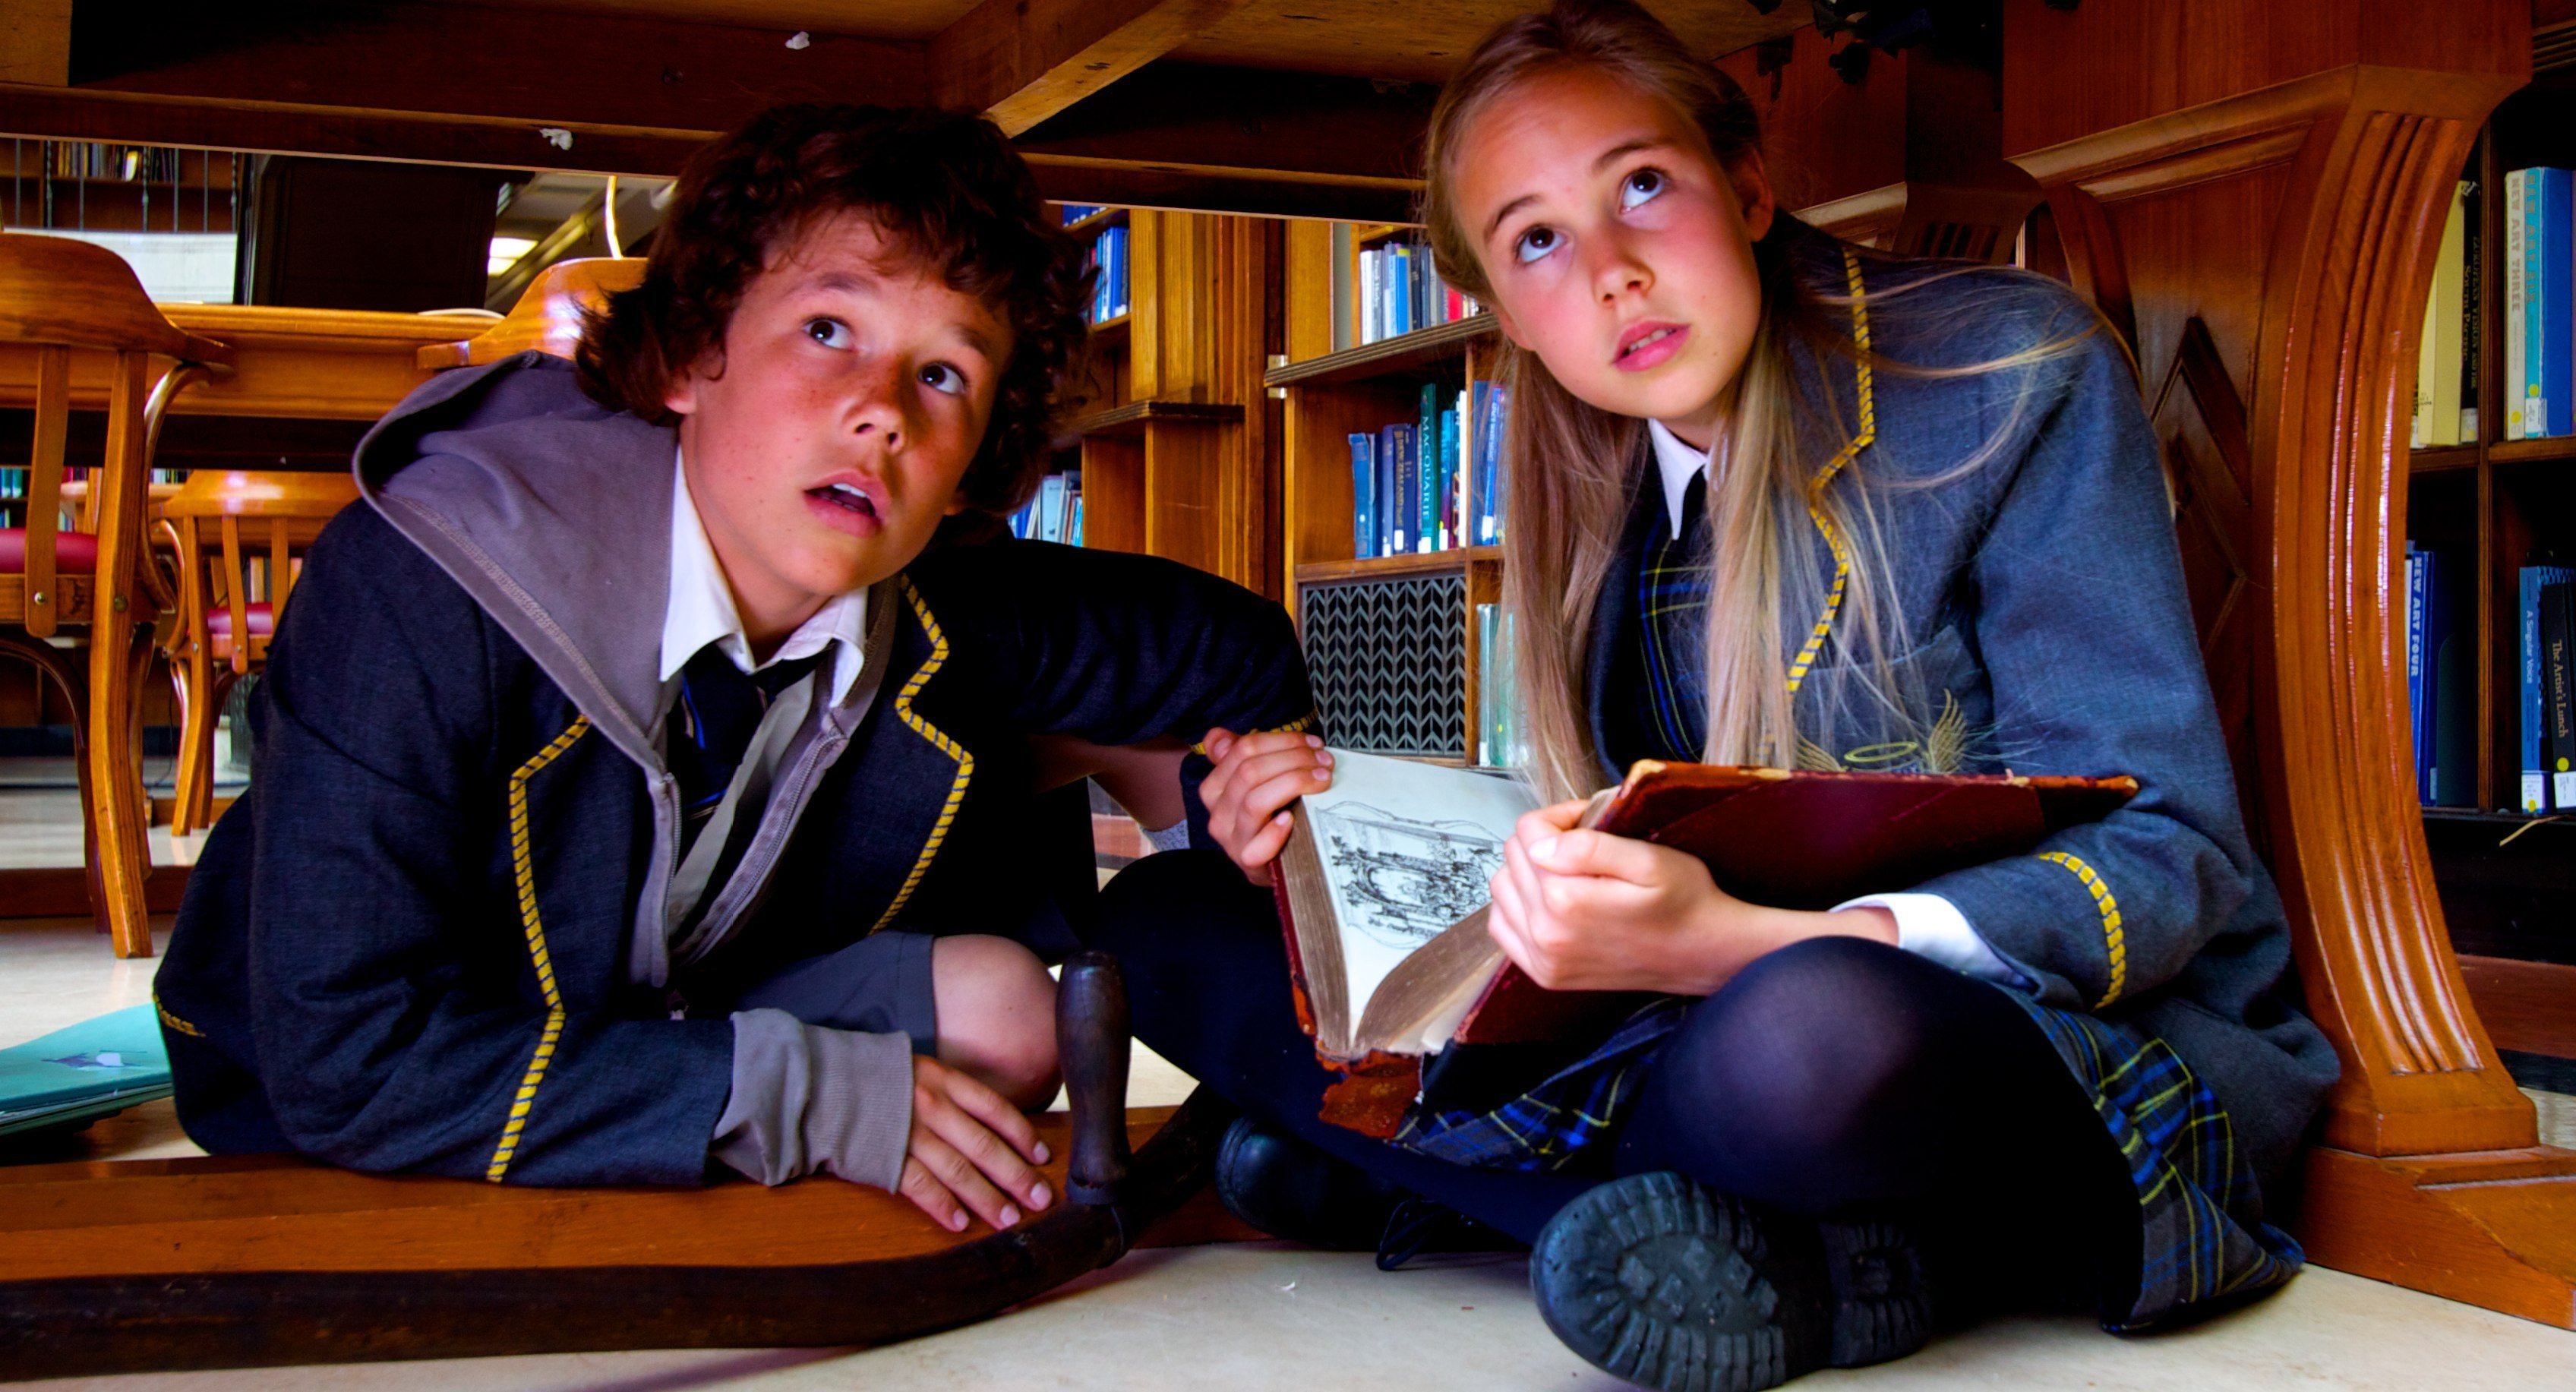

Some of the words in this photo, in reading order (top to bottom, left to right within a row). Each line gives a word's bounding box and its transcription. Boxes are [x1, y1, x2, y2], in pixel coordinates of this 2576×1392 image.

[2511, 177, 2520, 212] NEW
[2511, 218, 2520, 253] ART
[2511, 258, 2520, 313] THREE
[1422, 415, 1432, 520] MACQUARIE
[2413, 557, 2423, 592] NEW
[2411, 596, 2421, 630] ART
[2410, 634, 2420, 677] FOUR
[2525, 619, 2533, 658] Singular
[2552, 640, 2562, 661] The
[2553, 664, 2566, 700] Artist's
[2556, 702, 2568, 738] Lunch
